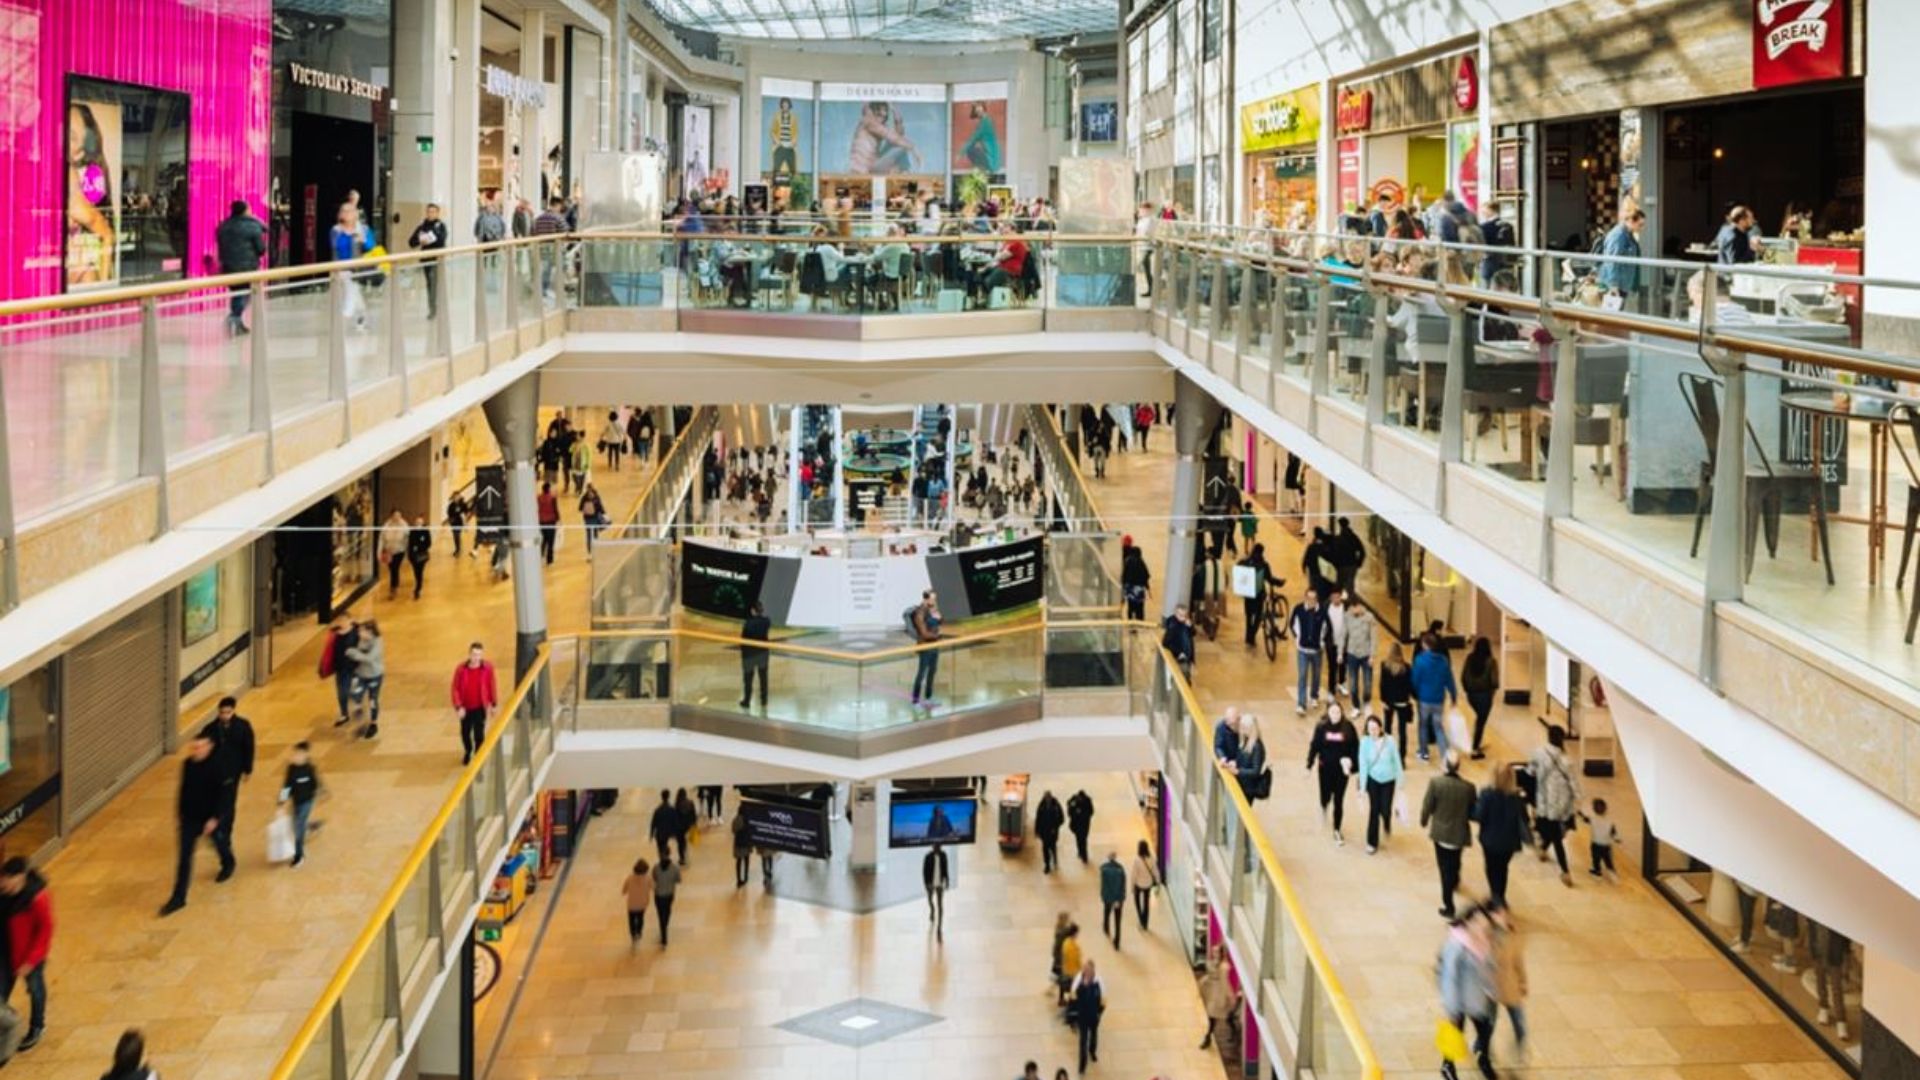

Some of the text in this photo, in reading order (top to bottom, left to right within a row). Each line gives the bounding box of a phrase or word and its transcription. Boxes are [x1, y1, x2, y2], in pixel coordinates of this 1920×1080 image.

[1771, 22, 1820, 46] BREAK
[290, 62, 382, 101] VICTORIA'S SECRET
